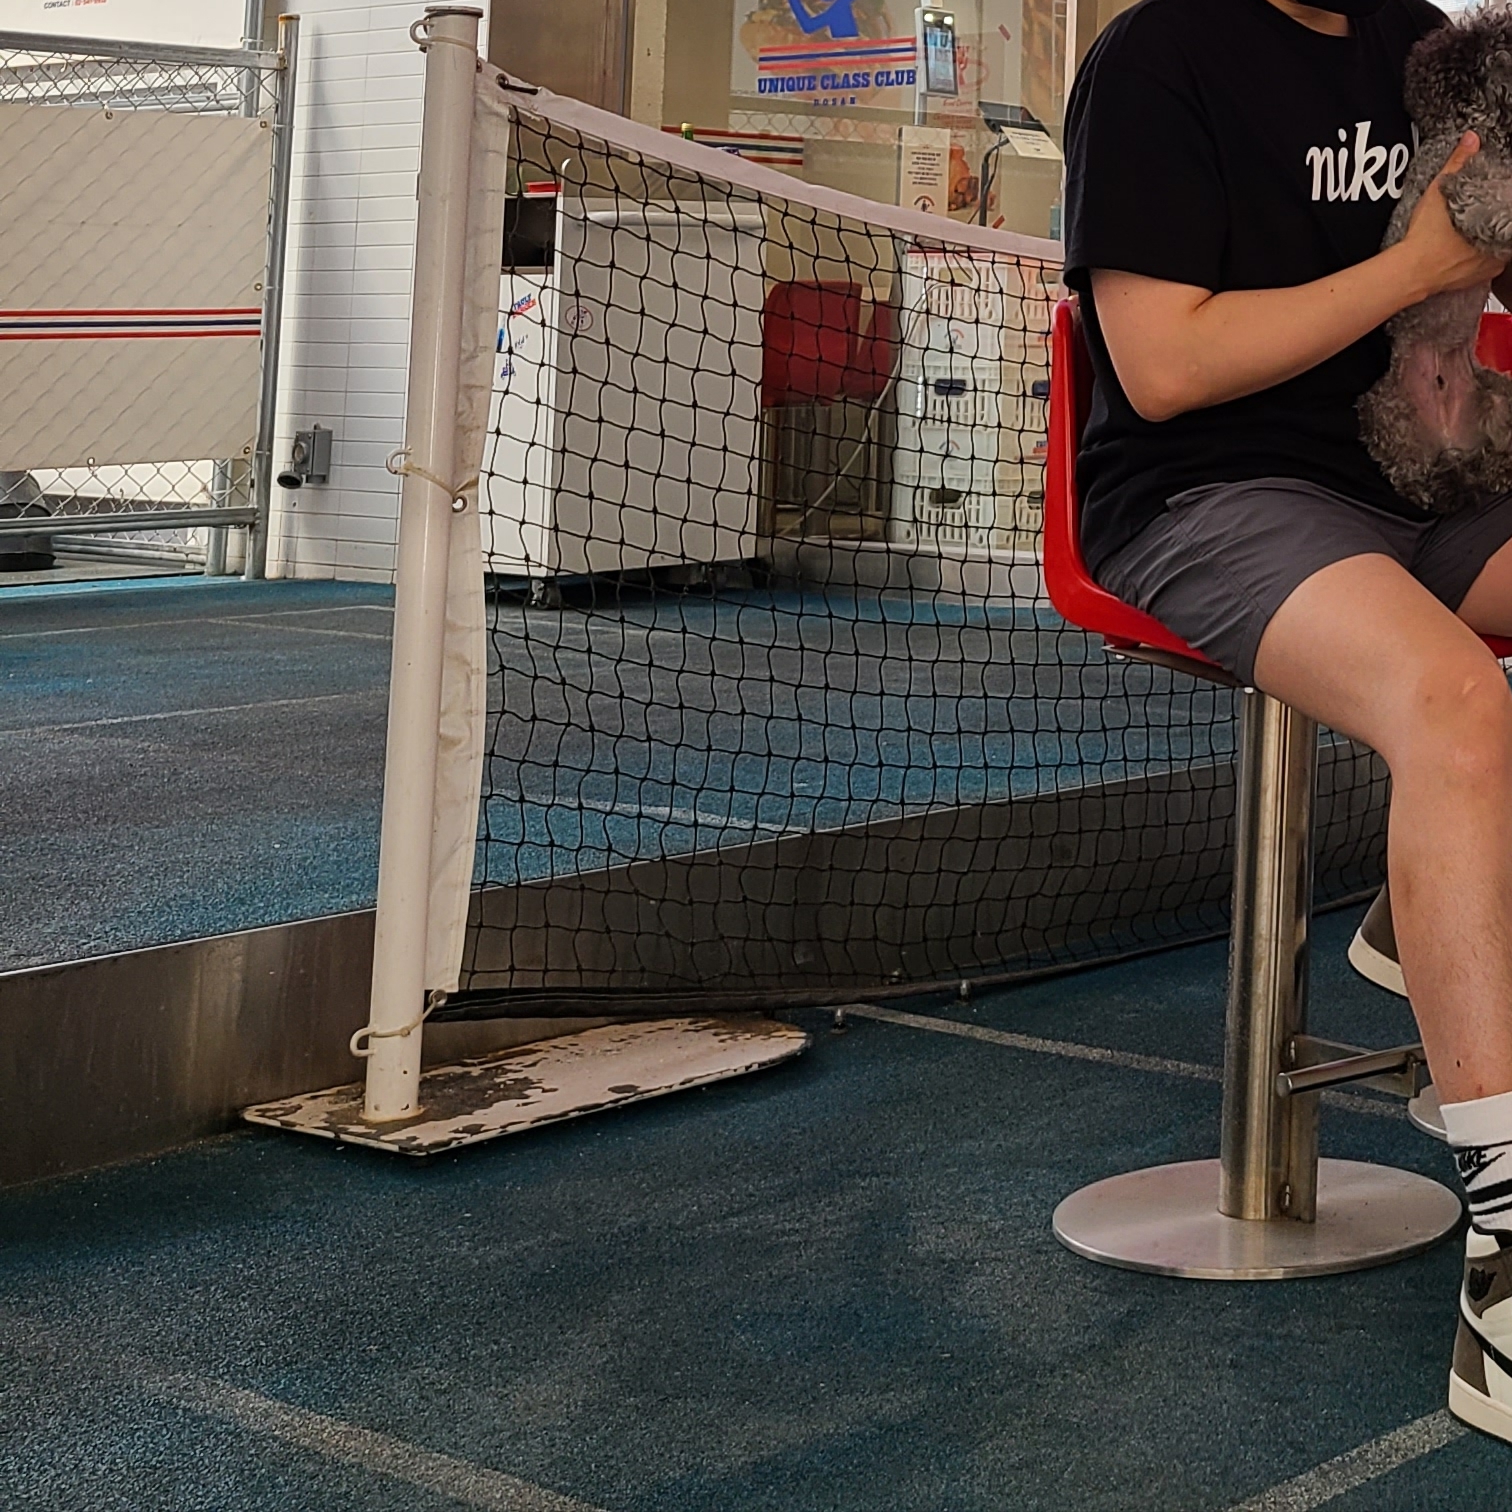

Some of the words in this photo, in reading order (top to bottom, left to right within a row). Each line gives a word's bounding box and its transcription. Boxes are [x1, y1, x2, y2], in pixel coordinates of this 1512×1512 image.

[758, 75, 817, 94] UNIQUE
[820, 72, 871, 90] CLASS
[874, 69, 917, 87] CLUB
[1305, 120, 1410, 202] nike
